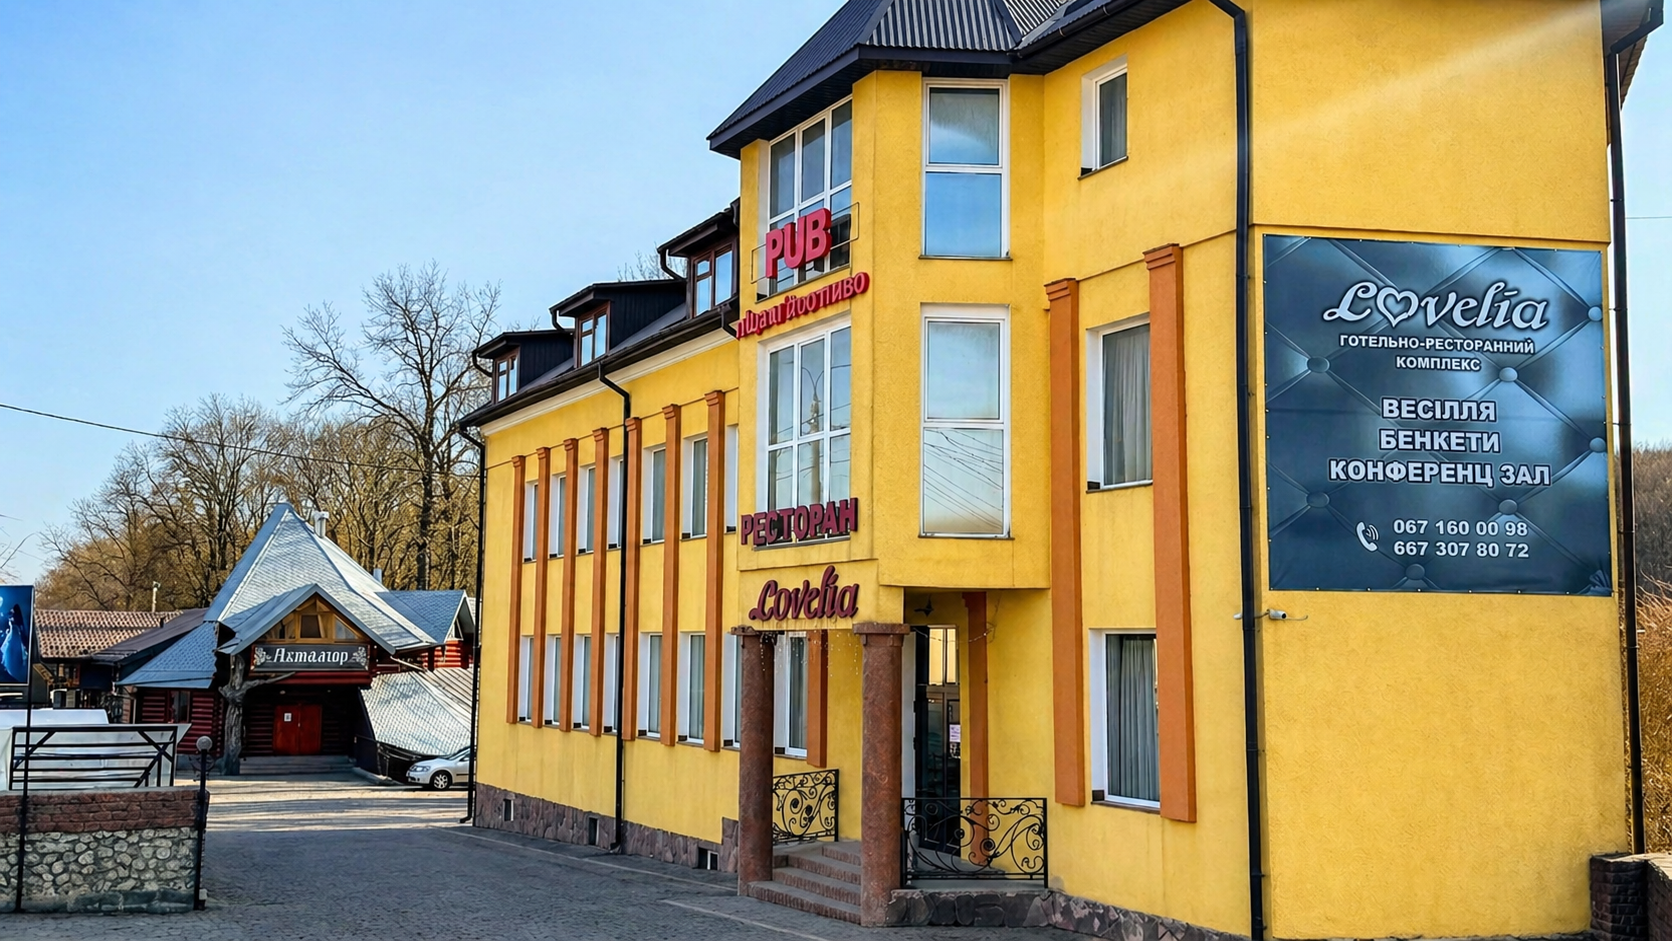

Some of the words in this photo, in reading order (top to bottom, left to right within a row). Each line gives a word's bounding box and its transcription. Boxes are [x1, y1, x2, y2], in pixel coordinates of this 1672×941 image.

[765, 207, 832, 279] PUB
[1340, 334, 1534, 354] ГОТЕЛЬНО-РЕСТОРАННИЙ
[1395, 356, 1481, 371] КОМПЛЕКС
[1382, 398, 1496, 421] ВЕСІЛЛЯ
[1379, 430, 1500, 453] БЕНКЕТИ
[1329, 460, 1493, 487] КОНФЕРЕНЦ
[1500, 465, 1550, 486] ЗАЛ
[740, 497, 858, 545] РЕСТОРАН
[1393, 519, 1429, 534] 067
[1435, 520, 1470, 535] 160
[1476, 521, 1499, 536] 00
[1505, 522, 1528, 536] 98
[1393, 541, 1429, 556] 667
[1435, 541, 1470, 557] 307
[1476, 542, 1499, 557] 80
[1505, 543, 1529, 558] 72
[748, 565, 860, 621] Lovelia
